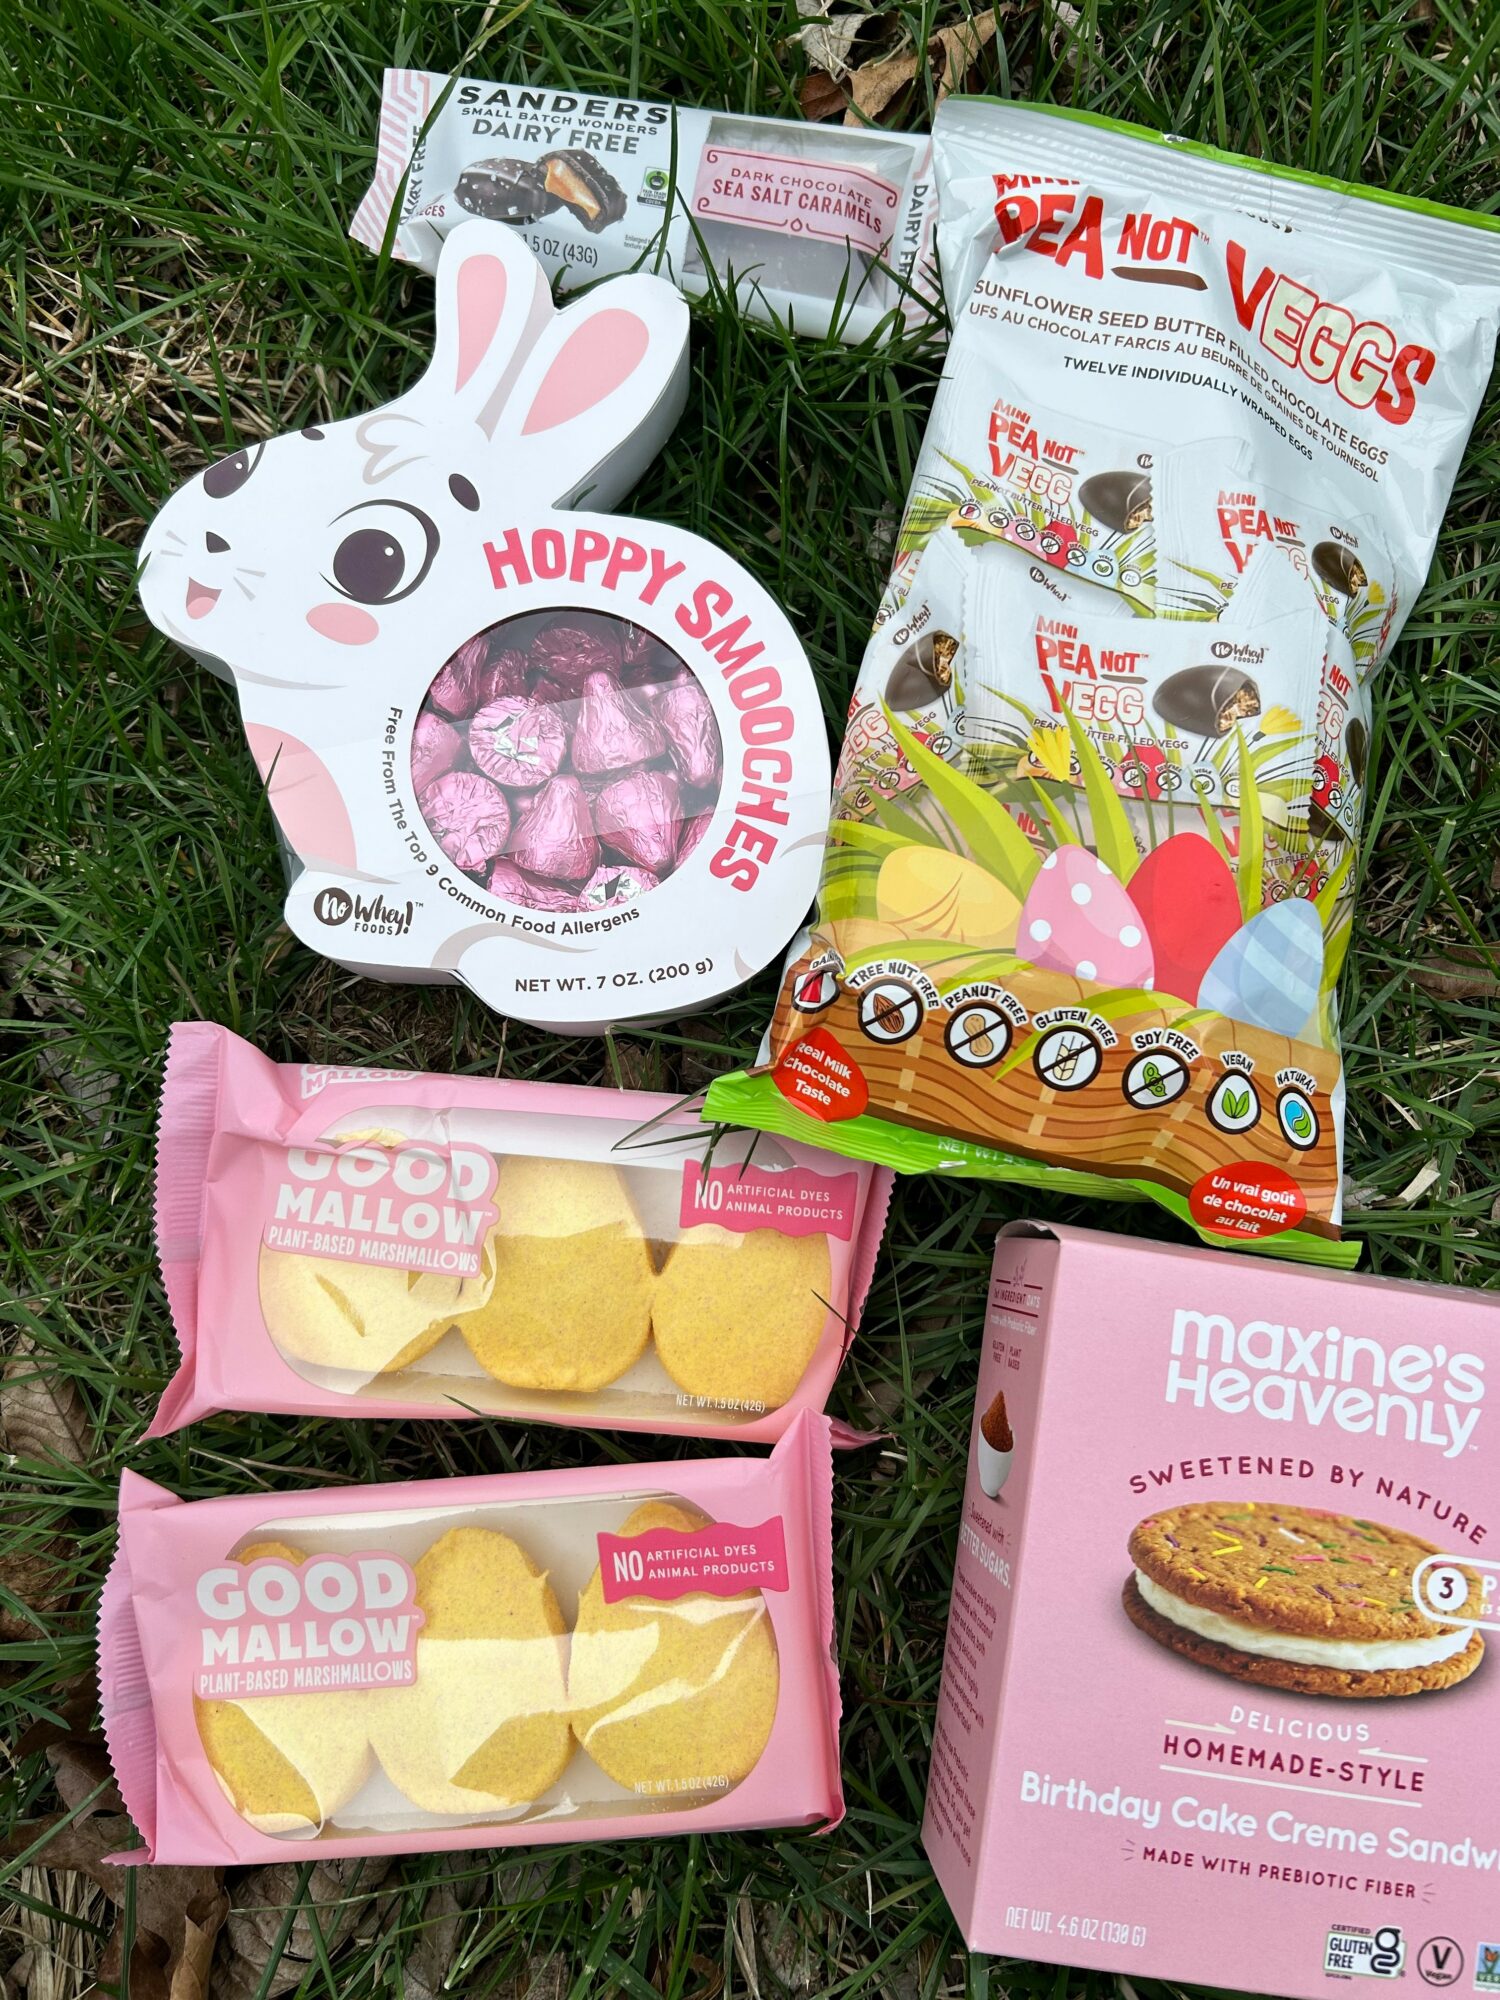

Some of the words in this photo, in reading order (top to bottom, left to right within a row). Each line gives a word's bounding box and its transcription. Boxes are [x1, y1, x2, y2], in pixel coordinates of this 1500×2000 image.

[457, 86, 669, 124] SANDERS
[461, 107, 513, 119] SMALL
[518, 112, 572, 125] BATCH
[578, 118, 658, 136] WONDERS
[472, 118, 561, 144] DAIRY
[568, 129, 640, 155] FREE
[712, 178, 744, 199] SEA
[751, 185, 793, 207] SALT
[798, 192, 882, 234] CARAMELS
[731, 167, 774, 184] DARK
[780, 175, 873, 209] CHOCOLATE
[904, 184, 929, 246] DAIRY
[543, 240, 560, 258] OZ
[563, 242, 598, 268] (43G)
[994, 194, 1104, 280] PEA
[1117, 213, 1199, 264] NOT
[1226, 239, 1437, 425] VEGGS
[973, 279, 1093, 324] SUNFLOWER
[1098, 310, 1149, 329] SEED
[1154, 316, 1226, 348] BUTTER
[1229, 339, 1270, 382] FILLED
[1271, 378, 1348, 443] CHOCOLATE
[1349, 434, 1389, 466] EGGS
[969, 302, 998, 319] UFS
[1001, 310, 1025, 325] AU
[1028, 316, 1112, 345] CHOCOLAT
[1114, 335, 1170, 352] FARCIS
[1174, 342, 1198, 356] AU
[1201, 346, 1249, 382] BEURRE
[1250, 376, 1263, 394] DE
[1264, 389, 1304, 429] GRAINES
[1305, 424, 1319, 441] DE
[1320, 434, 1379, 483] TOURNESOL
[1063, 355, 1128, 377] TWELVE
[1131, 366, 1239, 398] INDIVIDUALLY
[1240, 391, 1287, 439] WRAPPED
[1288, 433, 1313, 460] EGGS
[993, 397, 1032, 425] MINI
[988, 411, 1039, 461] PEA
[1042, 438, 1079, 465] NOT
[988, 443, 1073, 506] VEGG
[1011, 492, 1043, 512] BUTTER
[1044, 507, 1073, 525] FILLED
[1074, 522, 1099, 537] VEGG
[1319, 593, 1340, 605] VEGG
[1036, 615, 1078, 639] MINI
[1035, 634, 1097, 680] PEA
[1100, 649, 1140, 673] NOT
[483, 527, 686, 606] HOPPY
[675, 579, 795, 892] SMOOCHES
[1040, 673, 1144, 726] VEGG
[386, 707, 403, 745] Free
[911, 711, 937, 731] VEGG
[1158, 739, 1189, 751] VEGG
[382, 750, 396, 794] From
[388, 798, 407, 830] The
[404, 831, 428, 863] Top
[426, 863, 439, 876] 9
[314, 887, 353, 926] No
[354, 894, 414, 936] Whey!
[438, 877, 506, 923] Common
[354, 923, 394, 936] FOODS
[511, 915, 556, 934] Food
[561, 907, 640, 936] Allergens
[515, 978, 550, 992] NET
[557, 977, 591, 991] WT.
[597, 975, 606, 989] 7
[611, 971, 643, 987] OZ.
[648, 963, 691, 984] (200
[695, 957, 714, 975] g)
[850, 963, 884, 987] TREE
[888, 962, 918, 978] NUT
[915, 976, 939, 1008] FREE
[945, 984, 1000, 1008] PEANUT
[1001, 994, 1027, 1024] FREE
[1036, 1010, 1088, 1029] GLUTEN
[1091, 1018, 1116, 1046] FREE
[1134, 1030, 1162, 1049] SOY
[1165, 1030, 1198, 1060] FREE
[784, 1055, 851, 1097] Chocolate
[796, 1042, 823, 1064] Real
[824, 1054, 852, 1080] Milk
[1222, 1053, 1254, 1072] VEGAN
[796, 1079, 832, 1106] Taste
[1277, 1070, 1316, 1092] NATURAL
[287, 1147, 491, 1203] GOOD
[727, 1183, 795, 1199] ARTIFICIAL
[800, 1190, 830, 1202] DYES
[1211, 1175, 1233, 1191] Un
[1233, 1178, 1260, 1198] vrai
[1261, 1186, 1296, 1208] goût
[694, 1179, 722, 1211] NO
[726, 1201, 772, 1215] ANIMAL
[777, 1206, 843, 1220] PRODUCTS
[1203, 1194, 1223, 1208] de
[1224, 1198, 1287, 1224] chocolat
[274, 1184, 483, 1246] MALLOW
[1215, 1214, 1234, 1227] au
[1235, 1214, 1261, 1234] lait
[268, 1226, 355, 1256] PLANT-BASED
[359, 1239, 479, 1273] MARSHMALLOWS
[1026, 1294, 1041, 1309] OATS
[1170, 1308, 1485, 1403] maxine's
[676, 1394, 696, 1407] NET
[697, 1395, 713, 1408] WT.
[714, 1398, 726, 1409] 1.5
[728, 1399, 739, 1410] OZ
[740, 1399, 766, 1413] (42G)
[1129, 1456, 1315, 1494] SWEETENED
[1330, 1464, 1364, 1487] BY
[1376, 1477, 1488, 1546] NATURE
[613, 1550, 644, 1583] NO
[646, 1547, 719, 1562] ARTIFICIAL
[724, 1544, 757, 1557] DYES
[648, 1566, 698, 1580] ANIMAL
[703, 1560, 775, 1576] PRODUCTS
[979, 1542, 1011, 1590] SUGARS.
[196, 1559, 409, 1621] GOOD
[1439, 1576, 1454, 1599] 3
[201, 1615, 411, 1666] MALLOW
[200, 1669, 288, 1694] PLANT-BASED
[294, 1659, 413, 1688] MARSHMALLOWS
[1230, 1705, 1370, 1742] DELICIOUS
[1164, 1734, 1425, 1792] HOMEMADE-STYLE
[634, 1781, 652, 1793] NET
[655, 1779, 673, 1792] WT.
[690, 1778, 702, 1789] OZ
[702, 1775, 729, 1790] (42G)
[1019, 1770, 1161, 1829] Birthday
[1172, 1795, 1258, 1838] Cake
[1267, 1810, 1379, 1855] Creme
[1143, 1846, 1194, 1867] MADE
[1202, 1854, 1251, 1876] WITH
[1258, 1863, 1358, 1891] PREBIOTIC
[1365, 1879, 1415, 1899] FIBER
[1005, 1906, 1028, 1929] NET
[1031, 1909, 1053, 1934] WT.
[1057, 1915, 1079, 1937] 4.6
[1081, 1918, 1099, 1940] OZ
[1100, 1921, 1129, 1945] (130
[1132, 1926, 1147, 1947] G)
[1331, 1923, 1371, 1935] CERTIFIED
[1328, 1953, 1354, 1969] FREE
[1330, 1937, 1373, 1955] GLUTEN
[1432, 1944, 1453, 1970] V
